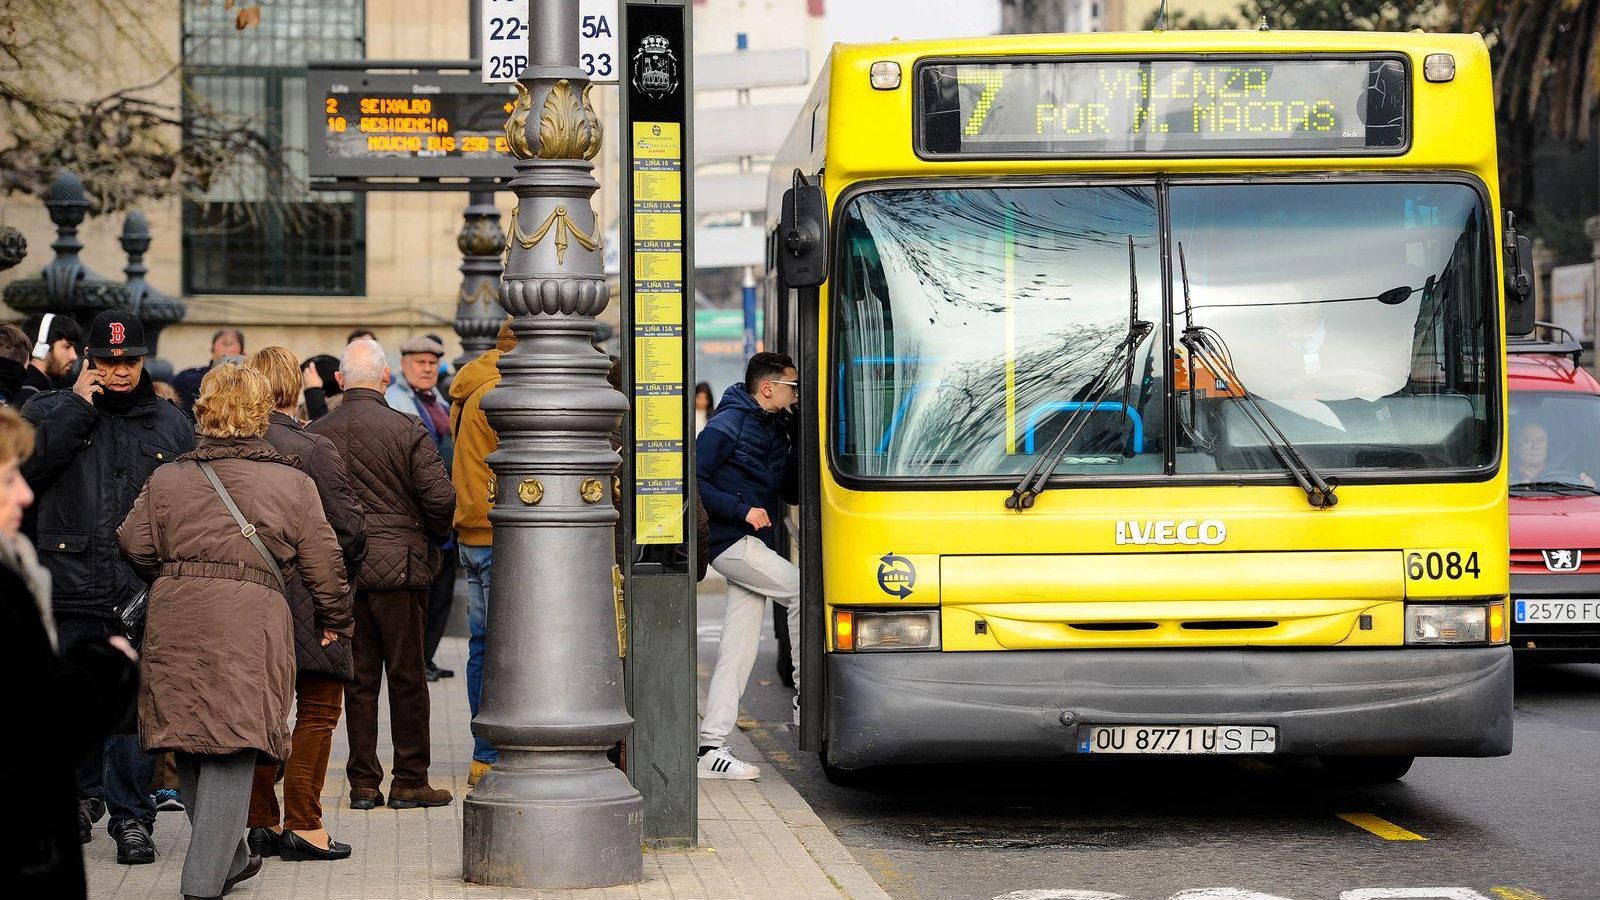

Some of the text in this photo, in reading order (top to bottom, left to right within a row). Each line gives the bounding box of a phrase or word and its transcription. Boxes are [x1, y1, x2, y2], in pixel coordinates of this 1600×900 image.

[581, 53, 612, 77] 33
[1100, 67, 1267, 99] VALENZA
[326, 98, 338, 114] 2
[360, 98, 432, 115] SEIXALBO
[957, 68, 1004, 135] 7
[327, 116, 449, 133] 10 RESIDENCIA
[1036, 103, 1110, 134] POR
[1193, 101, 1335, 133] MACIAS
[427, 135, 456, 152] BUS
[108, 322, 126, 345] B
[1114, 519, 1227, 545] IVECO
[1406, 551, 1481, 580] 6084
[1529, 603, 1577, 619] 2576
[1096, 728, 1126, 750] OU
